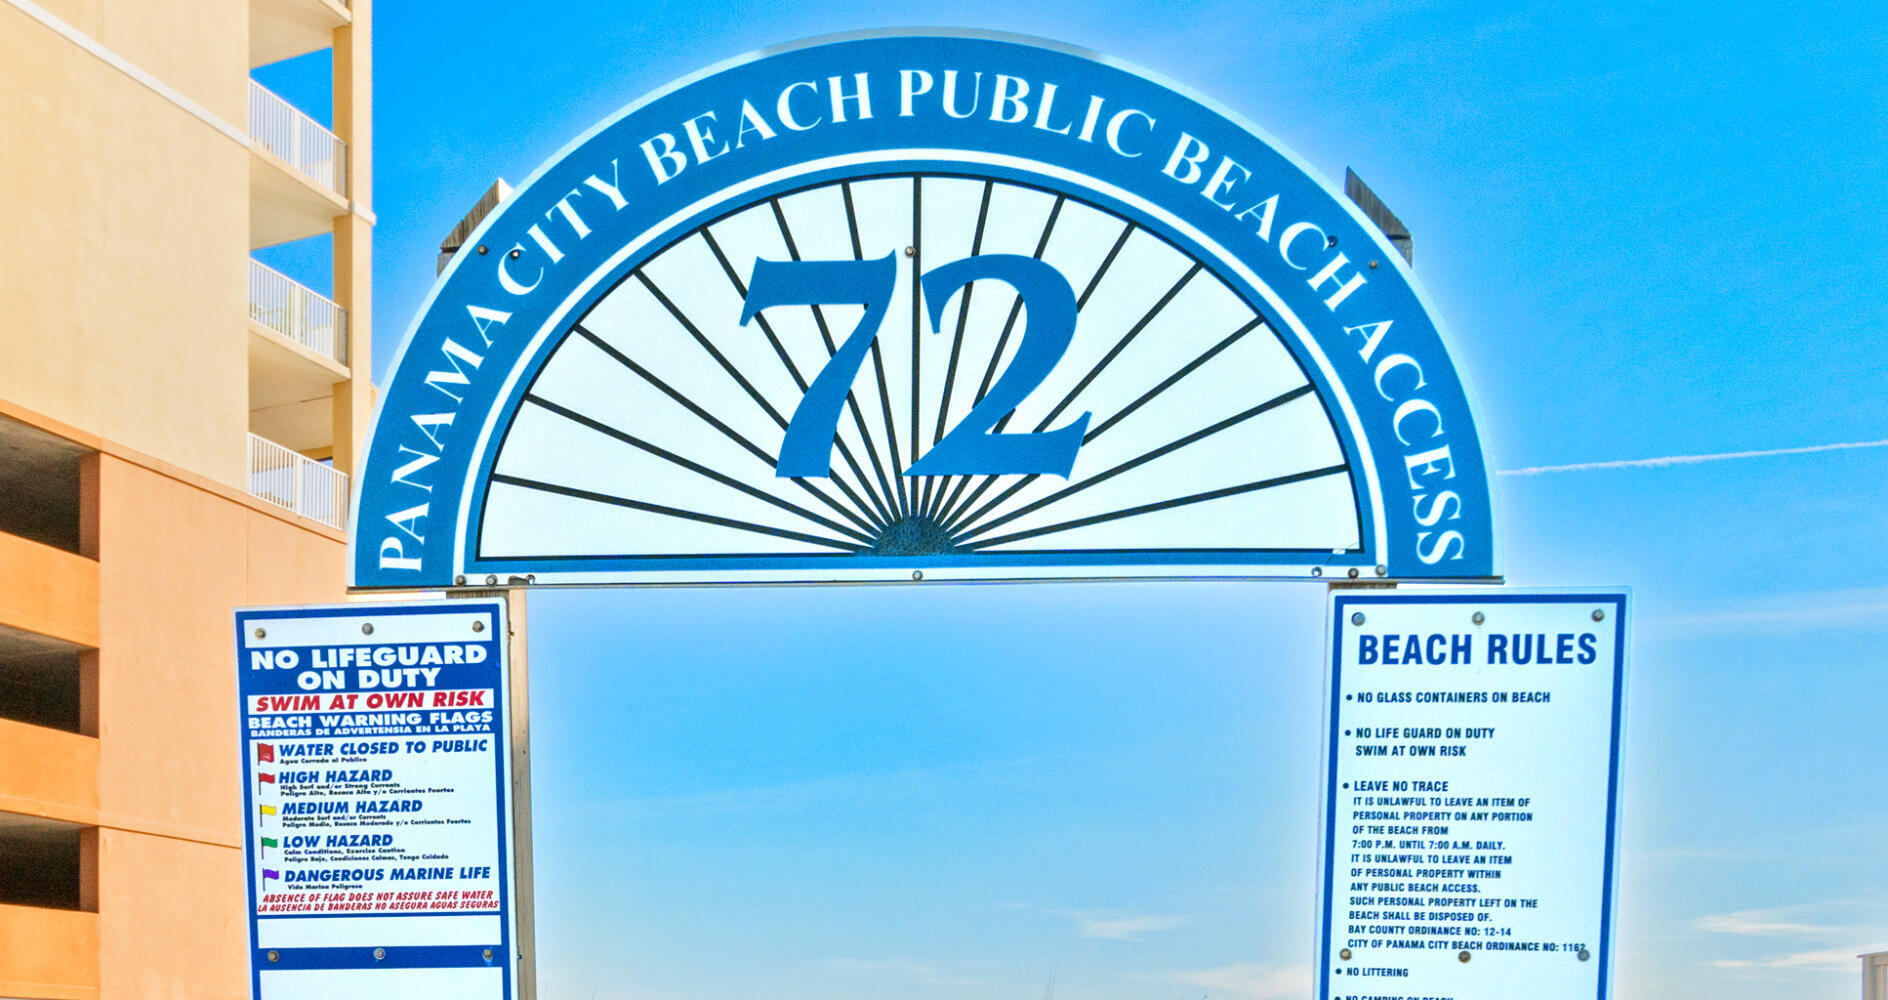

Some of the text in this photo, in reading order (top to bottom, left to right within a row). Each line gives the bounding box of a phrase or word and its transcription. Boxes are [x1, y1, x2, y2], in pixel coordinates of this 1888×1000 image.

[379, 69, 1465, 573] PANAMA CITY BEACH PUBLIC BEACH ACCESS
[739, 249, 1094, 481] 72
[1358, 632, 1597, 665] BEACH RULES
[251, 644, 487, 670] NO LIFEGUARD
[297, 667, 441, 691] ON DUTY
[256, 690, 485, 712] SWIM AT OWN RISK
[1357, 691, 1551, 703] NO GLASS CONTAINERS ON BEACH
[248, 710, 493, 731] BEACH WARNING FLAGS
[251, 724, 491, 737] BANDERAS DE ADVERTENSIA EN LA PLAYA
[1356, 727, 1495, 739] NO LIFE GUARD ON DUTY
[279, 739, 488, 757] WATER CLOSED TO PUBLIC
[1355, 745, 1466, 757] SWIM AT OWN RISK
[278, 769, 393, 785] HIGH HAZARD
[1354, 780, 1448, 792] LEAVE NO TRACE
[282, 799, 423, 815] MEDIUM HAZARD
[1353, 811, 1533, 822] PERSONAL PROPERTY ON ANY PORTION
[283, 834, 393, 848] LOW HAZARD
[1352, 839, 1506, 850] 7:00 P.M. UNTIL 7:00 A.M. DAILY.
[284, 866, 491, 882] DANGEROUS MARINE LIFE
[262, 890, 493, 905] ABSENCE OF FLAG DOES NOT ASSURE SAFE WATER
[1348, 925, 1511, 936] BAY COUNTY ORDINANCE NO: 12-14
[1346, 967, 1409, 977] NO LITTERING
